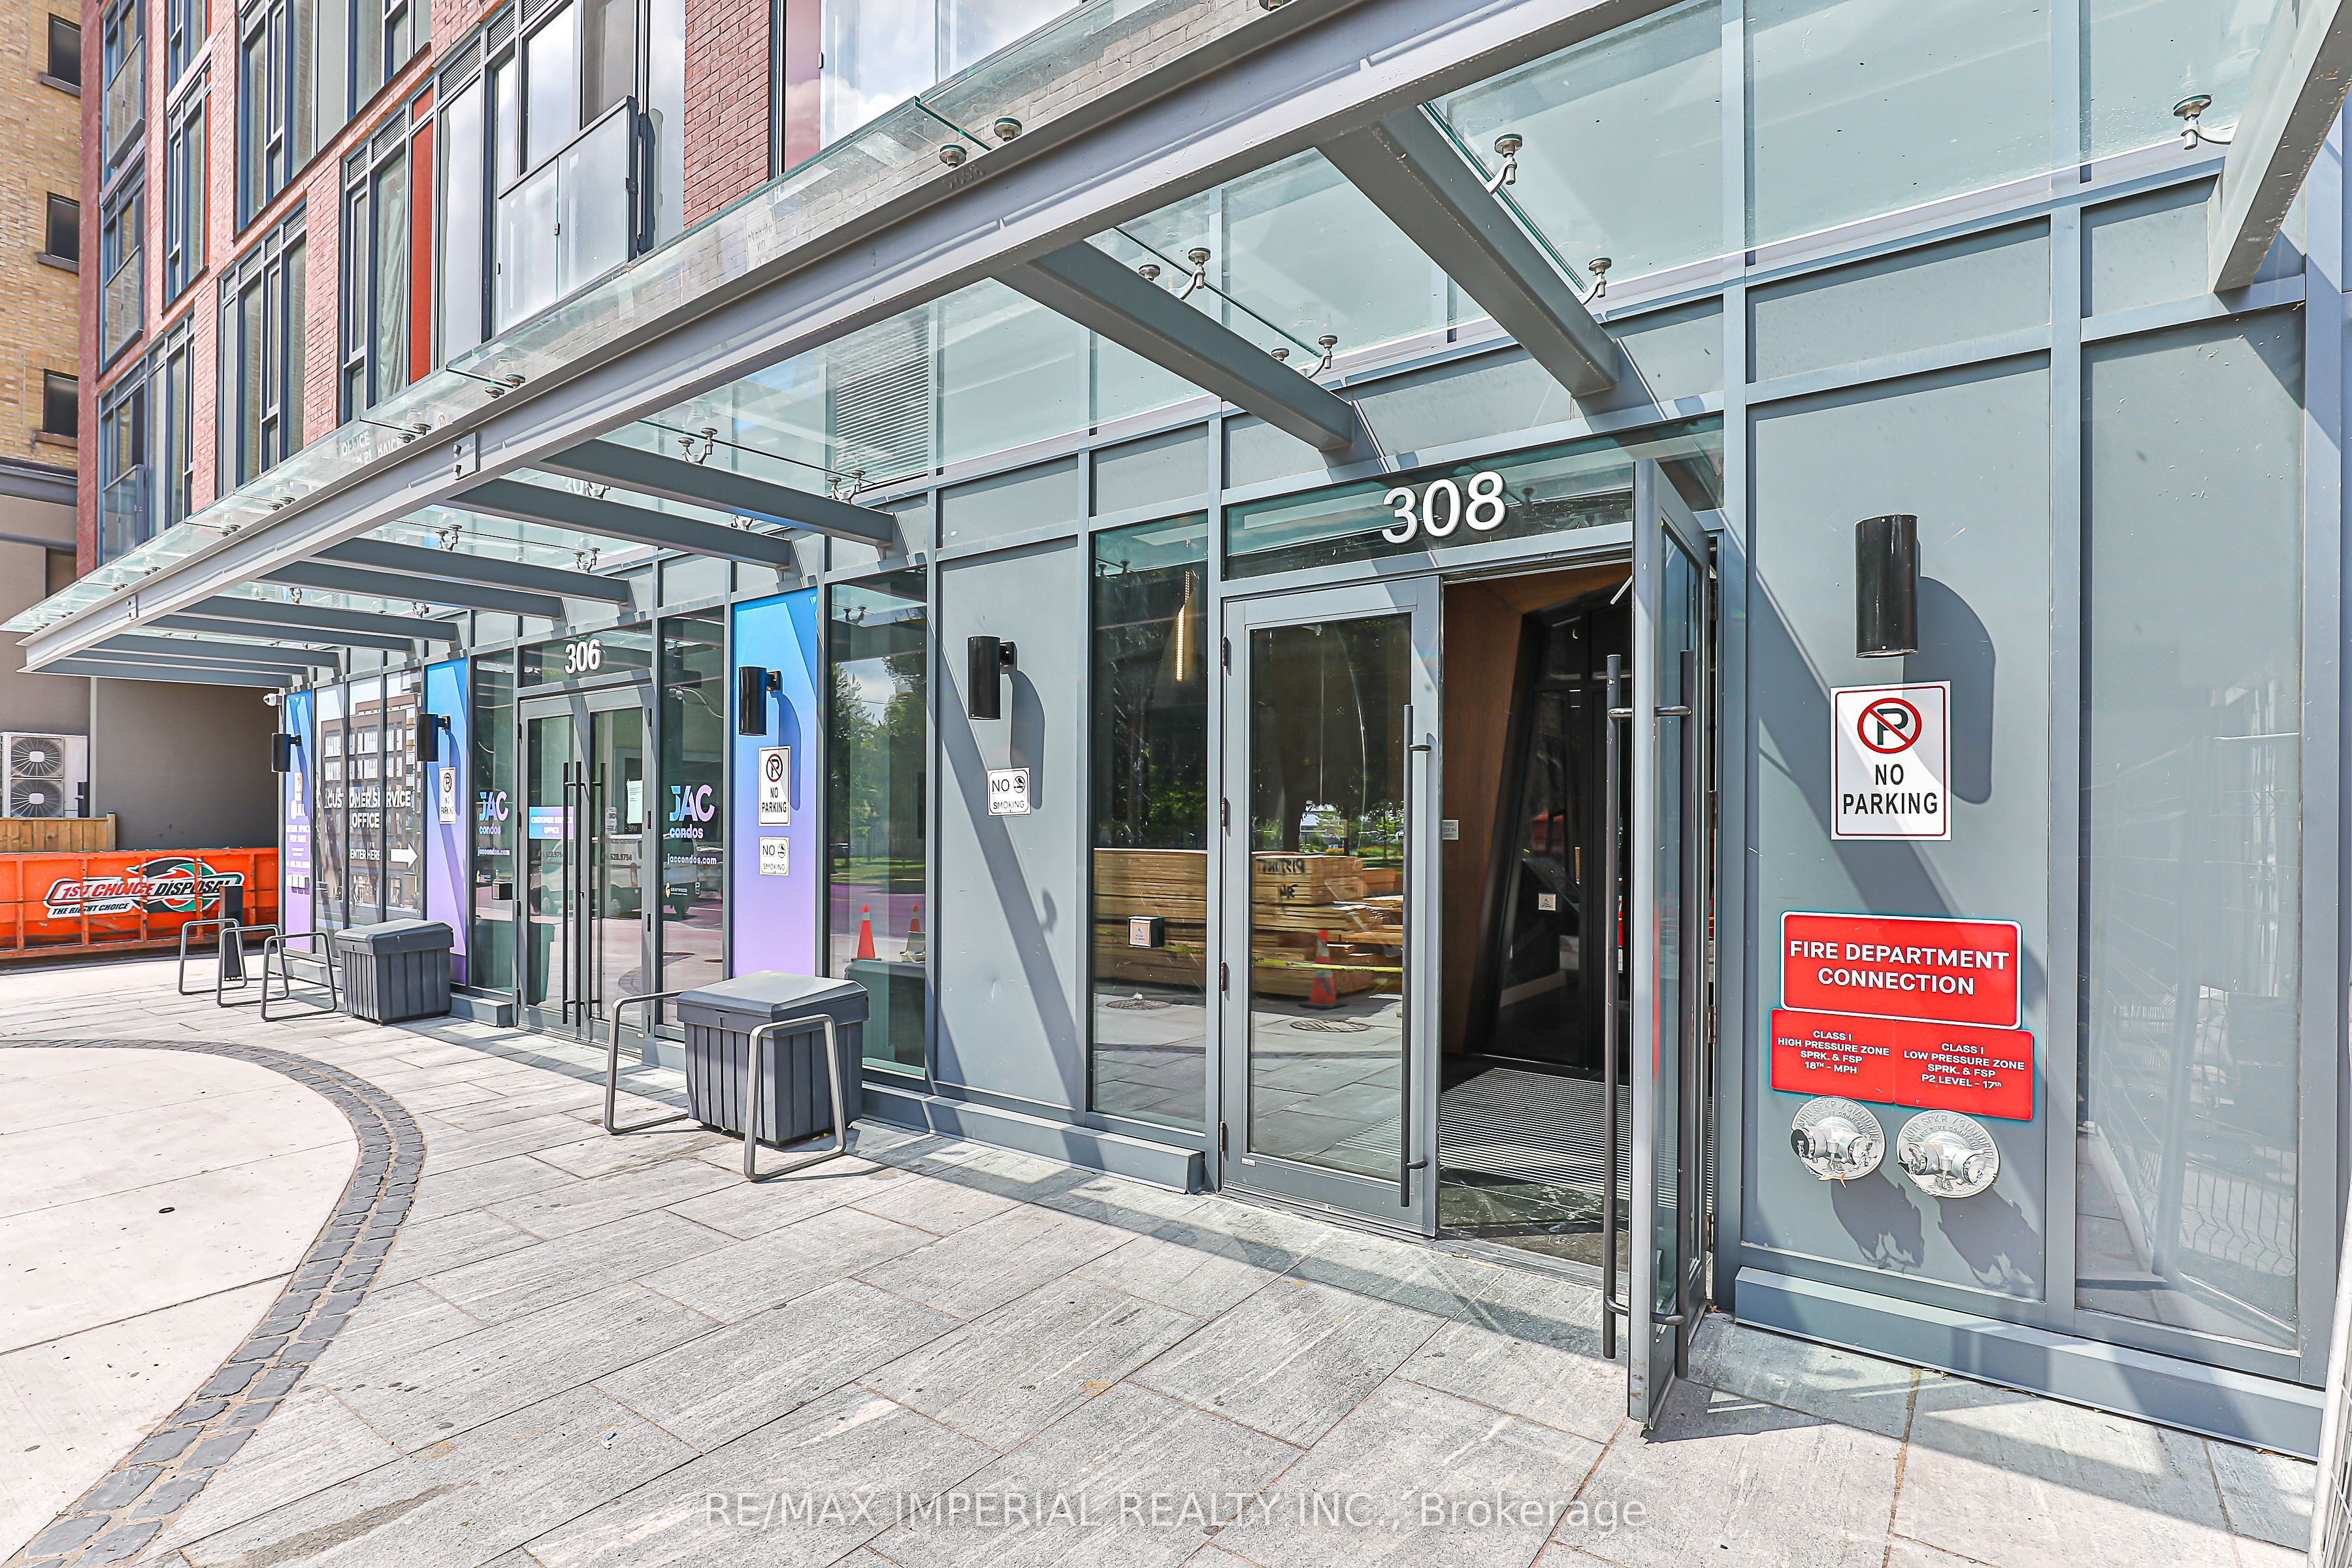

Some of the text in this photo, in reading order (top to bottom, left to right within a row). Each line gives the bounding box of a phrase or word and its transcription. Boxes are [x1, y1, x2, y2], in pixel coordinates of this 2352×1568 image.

[1382, 470, 1506, 544] 308
[564, 638, 601, 674] 306
[1875, 763, 1904, 785] NO
[770, 787, 779, 798] NO
[992, 779, 1009, 792] NO
[372, 790, 412, 808] SRVICE
[993, 800, 1024, 809] SMOKING
[1843, 792, 1938, 815] PARKING
[762, 802, 787, 813] PARKING
[352, 812, 380, 828] OFFICE
[479, 823, 502, 835] condos
[669, 824, 704, 839] condos
[350, 848, 380, 860] ENTER HERE
[762, 845, 776, 856] NO
[667, 853, 717, 865] jaccondos.com
[91, 882, 156, 897] CHOICE
[68, 905, 99, 915] RIGHT
[99, 902, 129, 912] CHOICE
[1789, 940, 2010, 970] FIRE DEPARTMENT
[1818, 968, 1975, 995] CONNECTION
[1813, 1030, 1846, 1041] CLASS
[1778, 1037, 1889, 1056] HIGH PRESSURE ZONE
[1941, 1043, 1978, 1054] CLASS
[1800, 1050, 1830, 1060] SPRK.
[1842, 1054, 1863, 1064] FSP
[1904, 1051, 2025, 1070] LOW PRESSURE ZONE
[1805, 1061, 1825, 1070] 18TH
[1833, 1064, 1857, 1074] MPH
[1927, 1064, 1960, 1075] SPRK.
[1974, 1069, 1997, 1078] FSP
[1921, 1074, 1936, 1083] P2
[1938, 1076, 1973, 1087] LEVEL
[1982, 1081, 2002, 1089] 17th
[1958, 1118, 1994, 1158] STANDPIP
